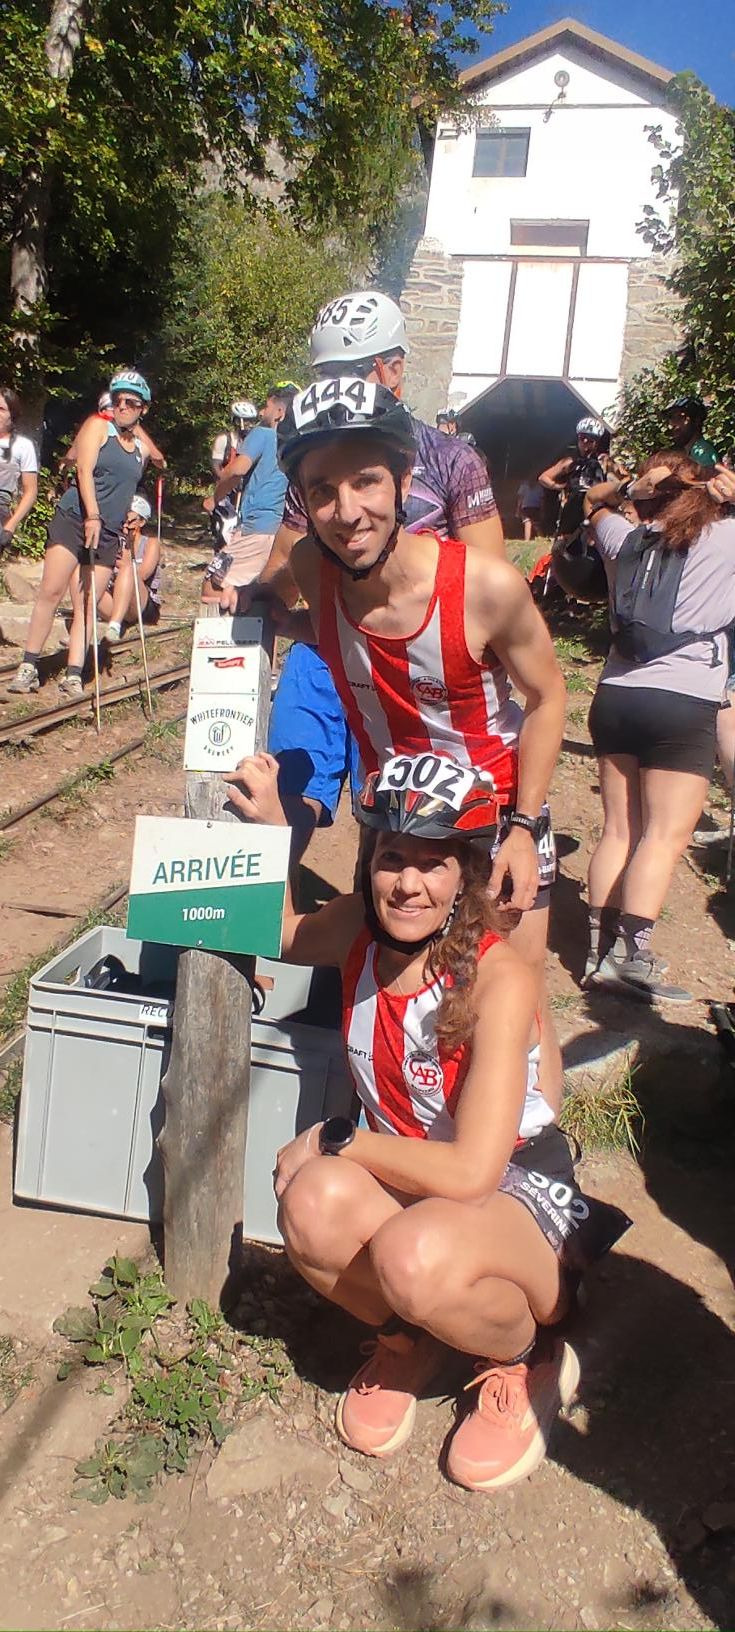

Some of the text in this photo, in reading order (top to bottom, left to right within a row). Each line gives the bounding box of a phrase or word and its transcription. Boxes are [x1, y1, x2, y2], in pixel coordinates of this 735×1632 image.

[300, 379, 367, 416] 444
[190, 708, 254, 727] WHITEFRONTIER
[388, 755, 465, 802] 502
[152, 849, 262, 885] ARRIVÉE
[182, 906, 226, 921] 1000m
[409, 1059, 438, 1086] CAB
[527, 1171, 590, 1229] 502
